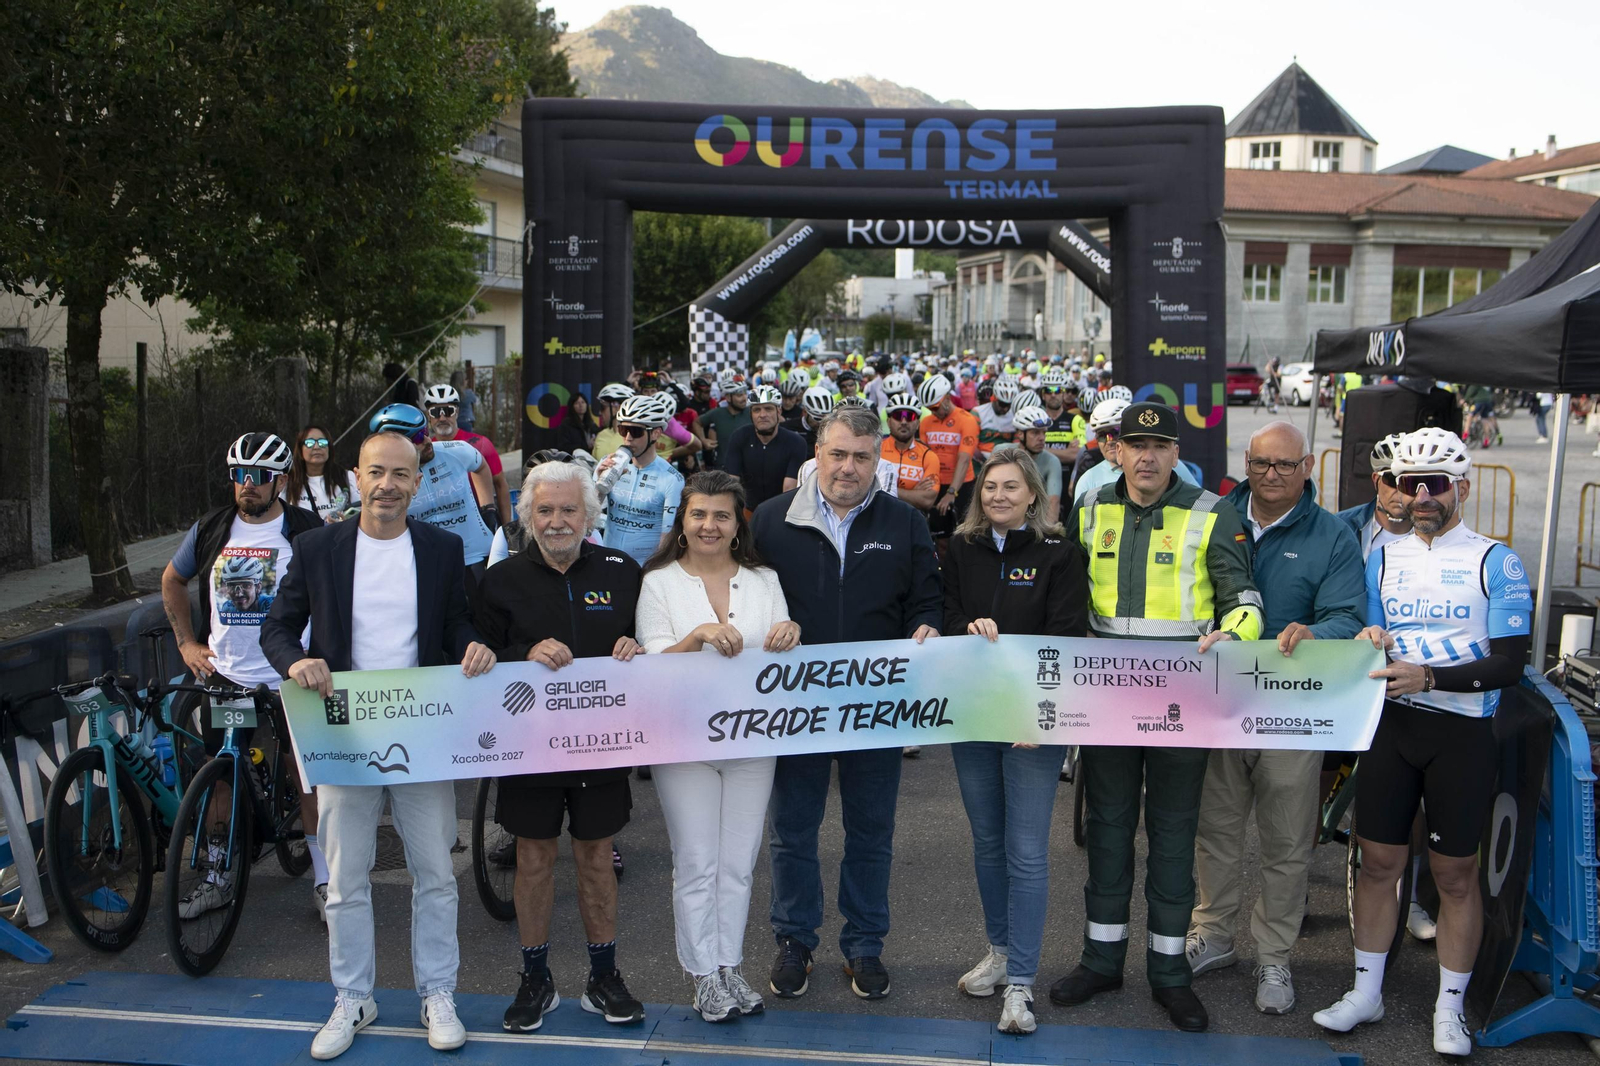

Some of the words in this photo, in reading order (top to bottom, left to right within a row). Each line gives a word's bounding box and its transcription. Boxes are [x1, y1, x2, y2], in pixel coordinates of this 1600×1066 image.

[694, 114, 1058, 173] OURENSE
[944, 179, 1058, 199] TERMAL
[847, 219, 1022, 245] RODOSA
[548, 257, 599, 265] DEPUTACIÓN
[716, 223, 814, 301] www.rodosa.com
[1152, 258, 1202, 267] DEPUTACIÓN
[555, 302, 585, 311] inorde
[1160, 303, 1190, 312] inorde
[1009, 568, 1037, 580] OU
[584, 591, 611, 604] OU
[1073, 656, 1203, 673] DEPUTACIÓN
[755, 656, 910, 694] OURENSE
[1073, 673, 1168, 688] OURENSE
[544, 680, 607, 696] GALICIA
[1263, 678, 1323, 690] inorde
[355, 688, 416, 704] XUNTA
[545, 693, 626, 711] CALIDADE
[73, 700, 101, 713] 163
[355, 707, 378, 721] DE
[383, 702, 454, 719] GALICIA
[224, 711, 244, 725] 39
[707, 706, 830, 742] STRADE
[838, 697, 954, 733] TERMAL
[1059, 711, 1087, 719] Concello
[1255, 717, 1312, 727] RODOSA
[1068, 720, 1091, 728] Lobios
[303, 750, 368, 764] Montalegre
[451, 752, 500, 764] Xacobeo
[501, 750, 524, 761] 2027
[99, 932, 120, 945] SWISS
